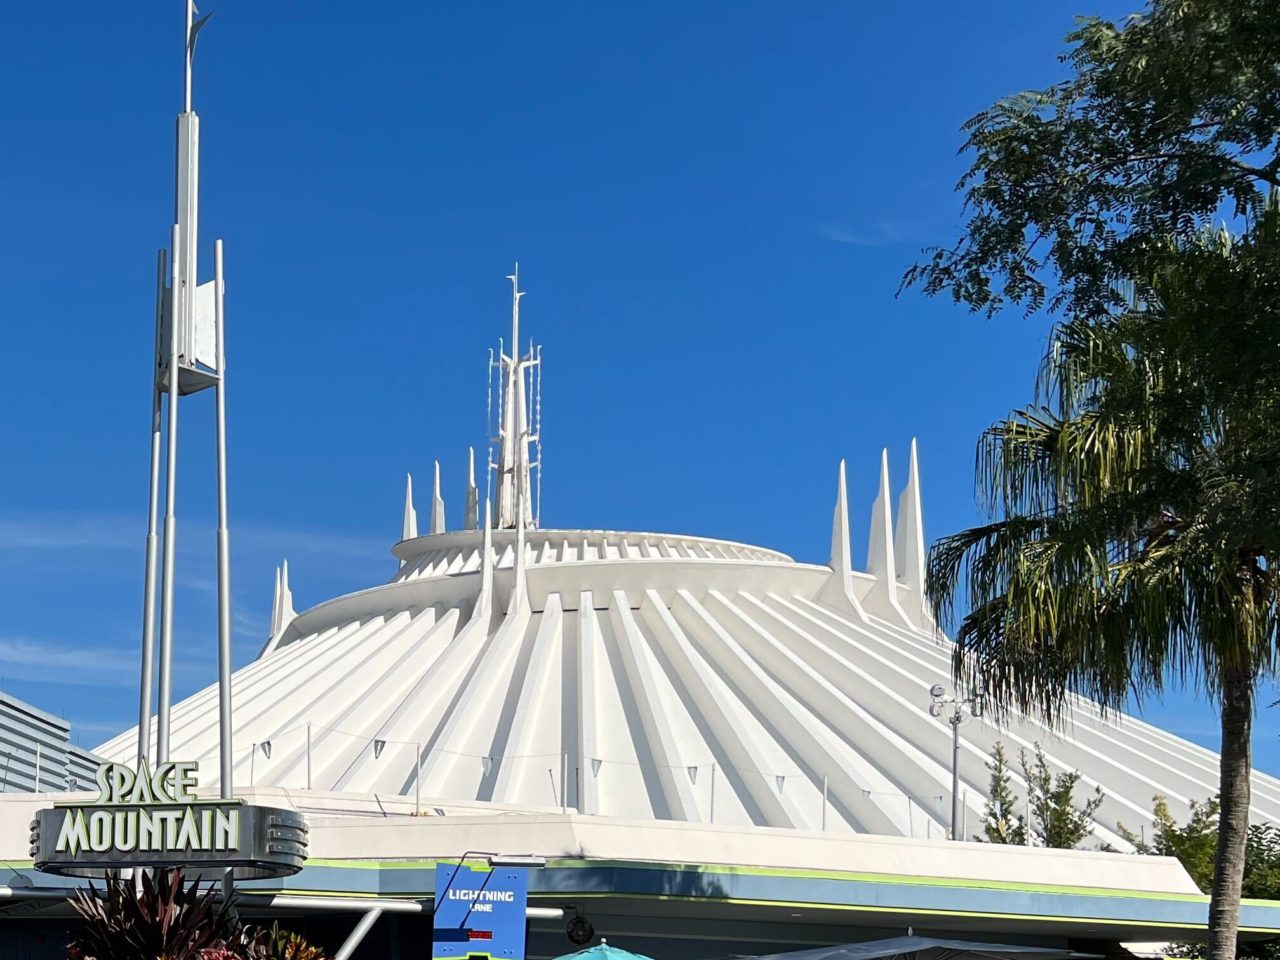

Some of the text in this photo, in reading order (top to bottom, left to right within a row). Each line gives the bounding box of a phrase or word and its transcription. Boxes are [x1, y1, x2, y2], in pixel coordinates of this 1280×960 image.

[95, 755, 199, 804] SPACE
[55, 806, 240, 859] MOUNTAIN
[449, 890, 514, 902] LIGHTNING
[470, 903, 492, 912] LANE
